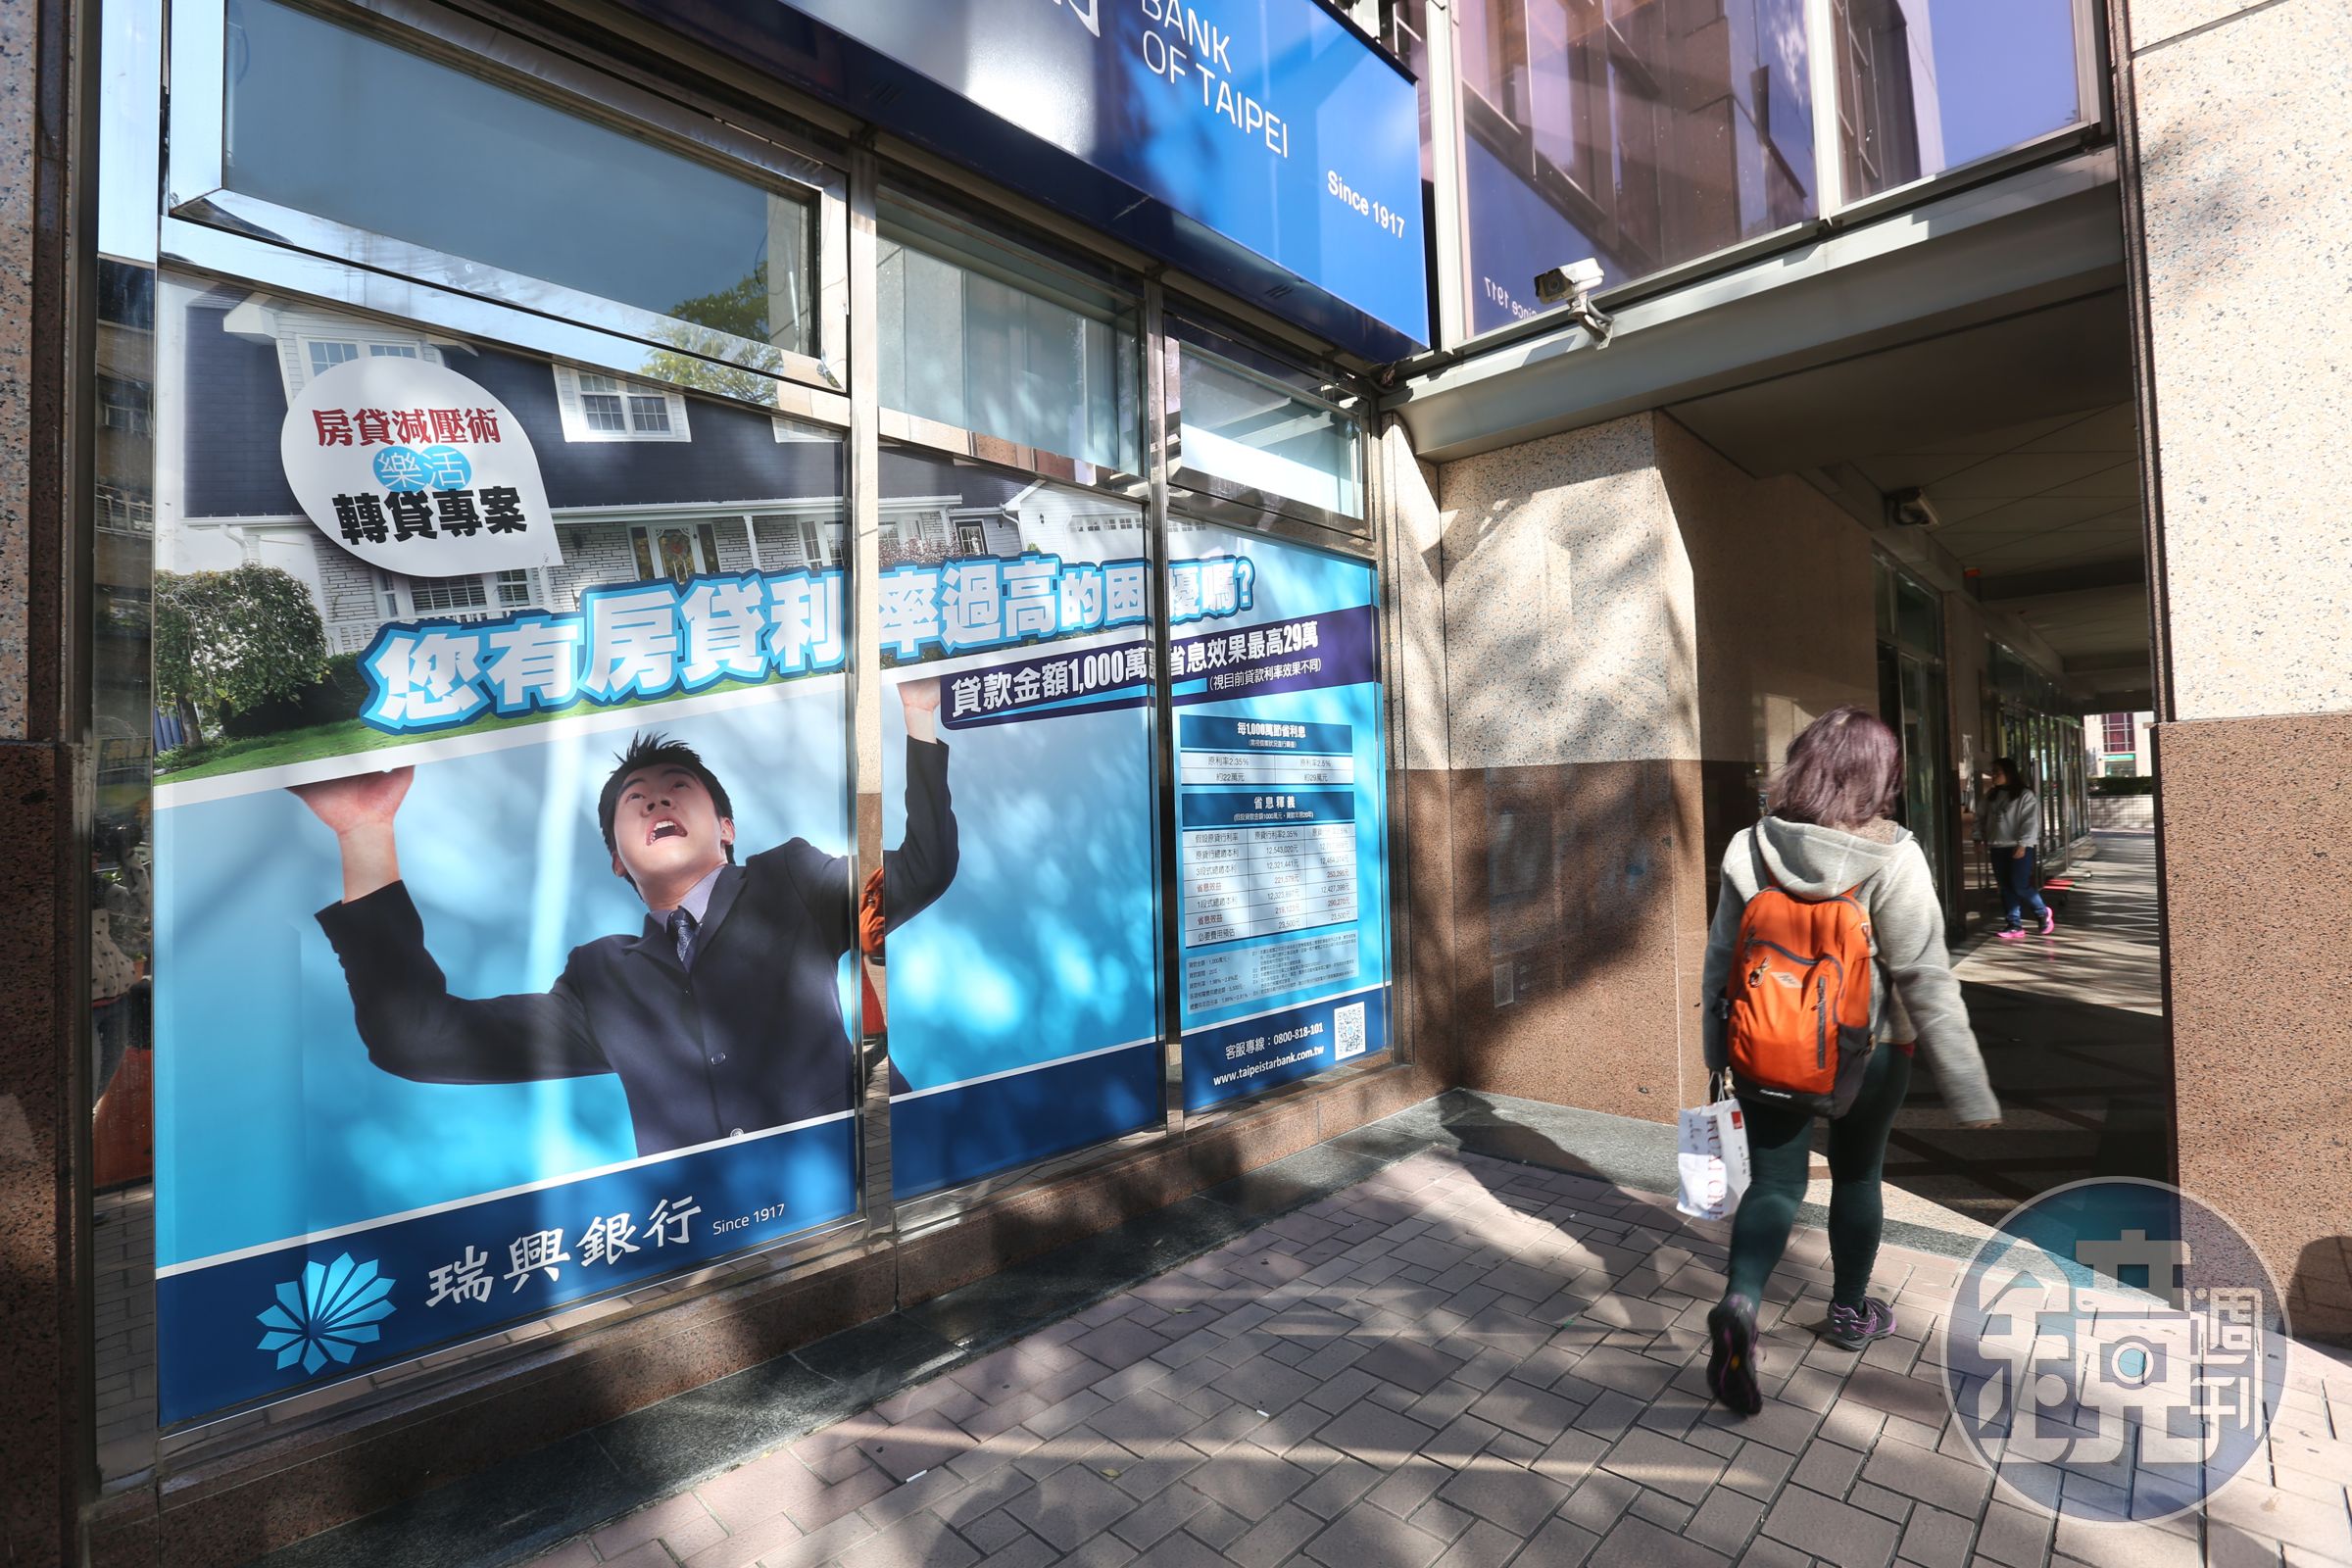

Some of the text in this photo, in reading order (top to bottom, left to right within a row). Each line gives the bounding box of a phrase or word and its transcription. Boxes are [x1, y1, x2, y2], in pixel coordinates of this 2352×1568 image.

[1143, 29, 1288, 159] OF TAIPEI
[1327, 170, 1405, 239] Since 1917
[312, 408, 502, 447] 房貸減壓術
[377, 450, 466, 489] 樂活
[331, 486, 528, 546] 轉貸專案
[1213, 1045, 1325, 1087] www.taipeistarbank.com.tw
[425, 1196, 785, 1308] 瑞興銀行 Since 1917
